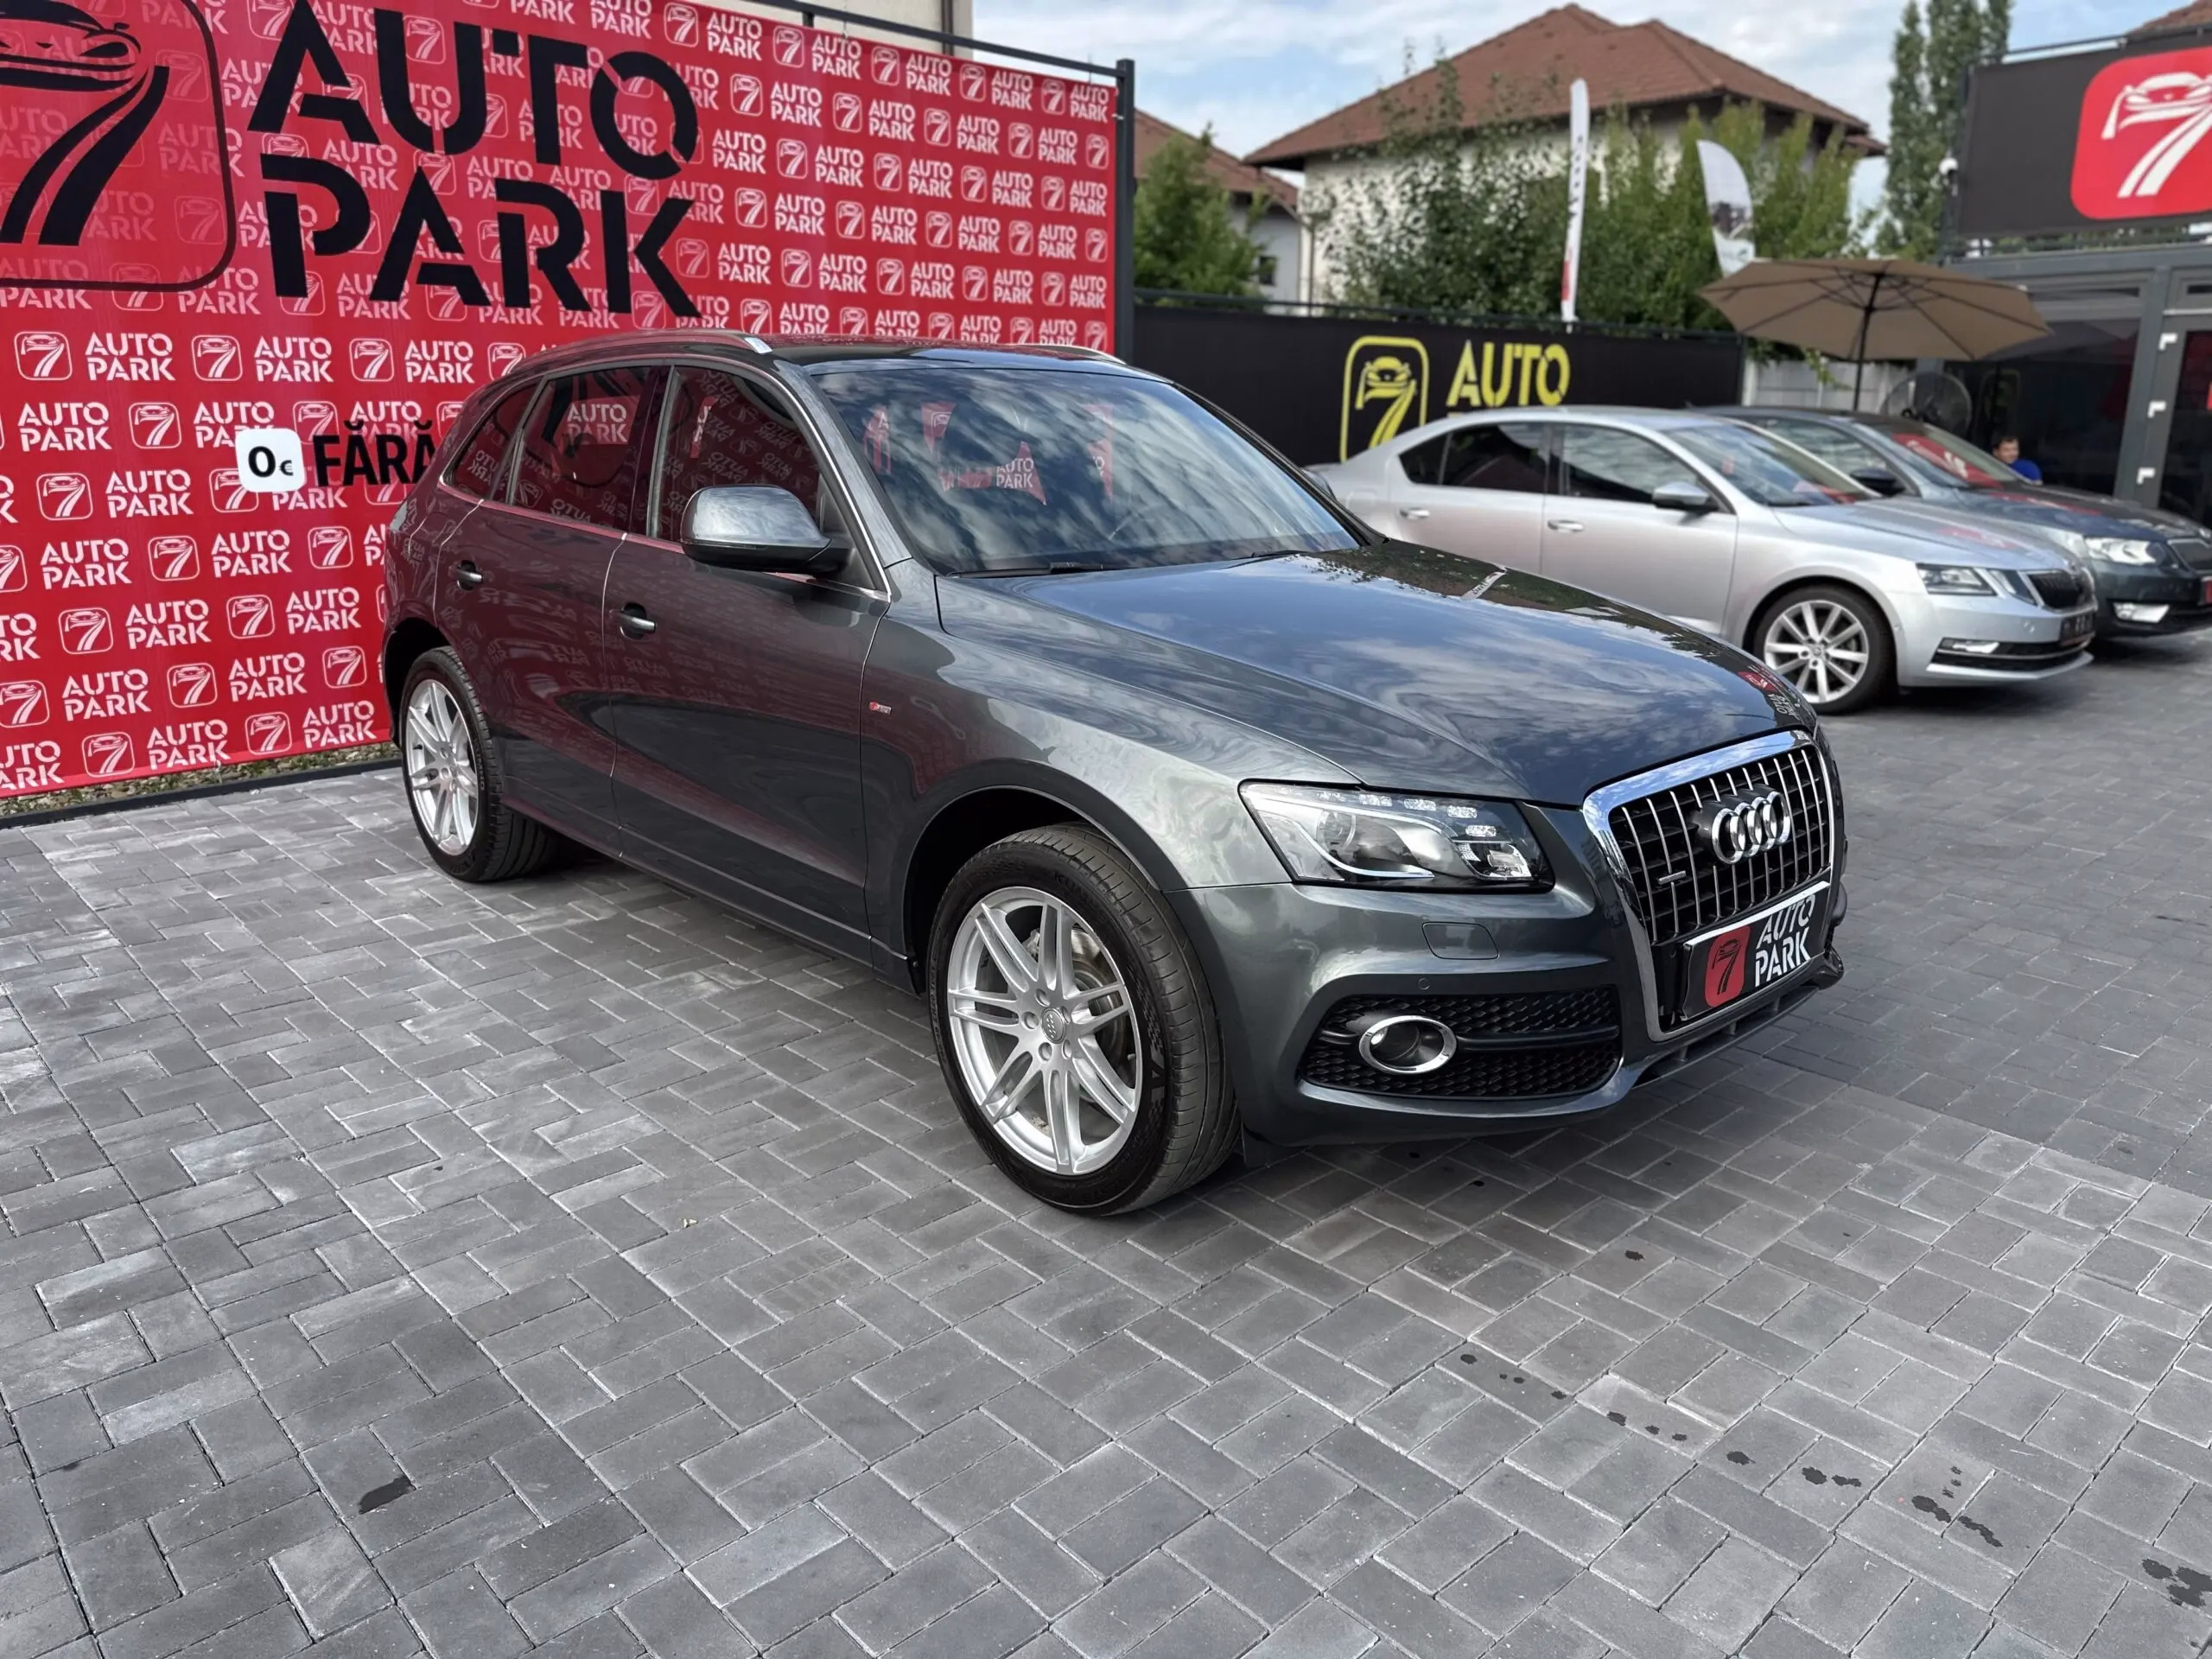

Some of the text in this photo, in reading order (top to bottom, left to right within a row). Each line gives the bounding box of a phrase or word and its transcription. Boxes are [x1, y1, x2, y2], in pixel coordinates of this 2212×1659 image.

[510, 0, 576, 24] PARK
[591, 7, 651, 38] PARK
[707, 13, 761, 39] AUTO
[708, 31, 761, 60] PARK
[811, 35, 861, 60] AUTO
[812, 52, 860, 79] PARK
[906, 54, 951, 75] AUTO
[247, 0, 698, 180] AUTO
[906, 71, 950, 95] PARK
[992, 72, 1033, 92] AUTO
[771, 82, 822, 107] AUTO
[992, 87, 1033, 111] PARK
[1071, 86, 1108, 106] AUTO
[772, 100, 821, 127] PARK
[869, 100, 915, 123] AUTO
[1071, 99, 1108, 123] PARK
[869, 117, 914, 142] PARK
[957, 115, 999, 137] AUTO
[1039, 128, 1077, 147] AUTO
[322, 138, 397, 167] AUTO
[713, 130, 766, 154] AUTO
[957, 132, 998, 154] PARK
[1039, 143, 1076, 164] PARK
[714, 149, 766, 174] PARK
[815, 145, 863, 168] AUTO
[467, 156, 533, 181] AUTO
[550, 166, 611, 190] AUTO
[816, 162, 862, 187] PARK
[908, 159, 952, 179] AUTO
[467, 177, 497, 200] PA
[668, 180, 724, 204] AUTO
[908, 175, 952, 198] PARK
[992, 171, 1033, 190] AUTO
[1070, 181, 1107, 198] AUTO
[775, 194, 825, 216] AUTO
[992, 188, 1033, 207] PARK
[1070, 194, 1106, 216] PARK
[86, 215, 157, 241] ARK
[776, 212, 824, 235] PARK
[872, 207, 917, 226] AUTO
[957, 215, 1000, 234] AUTO
[260, 152, 702, 317] PARK
[872, 223, 916, 245] PARK
[959, 232, 999, 252] PARK
[1038, 225, 1077, 242] AUTO
[718, 244, 771, 264] AUTO
[1039, 238, 1076, 258] PARK
[719, 262, 771, 283] PARK
[819, 254, 866, 274] AUTO
[911, 263, 953, 282] AUTO
[819, 270, 866, 292] PARK
[911, 278, 953, 298] PARK
[994, 270, 1033, 288] AUTO
[1070, 276, 1106, 291] AUTO
[0, 287, 92, 309] PARK
[178, 291, 261, 315] PARK
[994, 285, 1032, 304] PARK
[1071, 289, 1106, 308] PARK
[338, 296, 411, 320] PARK
[478, 305, 543, 327] PARK
[780, 303, 830, 323] AUTO
[875, 310, 919, 328] AUTO
[961, 315, 1001, 333] AUTO
[1039, 319, 1077, 338] AUTO
[86, 333, 172, 356] AUTO
[254, 337, 332, 359] AUTO
[404, 340, 473, 361] AUTO
[87, 358, 175, 380] PARK
[256, 359, 334, 382] PARK
[406, 362, 474, 383] PARK
[1446, 340, 1571, 407] AUTO
[18, 402, 109, 426] AUTO
[194, 402, 274, 423] AUTO
[350, 401, 422, 422] AUTO
[567, 404, 626, 423] AUTO
[20, 427, 111, 451] PARK
[105, 469, 190, 493] AUTO
[996, 473, 1033, 489] PARK
[108, 493, 193, 518] PARK
[41, 538, 129, 565] AUTO
[211, 530, 289, 555] AUTO
[42, 562, 131, 589] PARK
[213, 552, 291, 577] PARK
[286, 588, 359, 613] AUTO
[125, 600, 208, 626] AUTO
[288, 608, 360, 634] PARK
[128, 621, 211, 649] PARK
[229, 652, 305, 680] AUTO
[62, 669, 148, 698] AUTO
[231, 673, 307, 702] PARK
[65, 690, 151, 721] PARK
[302, 701, 374, 728] AUTO
[147, 720, 227, 748] AUTO
[304, 721, 380, 750] PARK
[149, 741, 231, 771] PARK
[0, 763, 64, 790] ARK
[1756, 893, 1816, 950] AUTO
[1755, 926, 1812, 987] PARK
